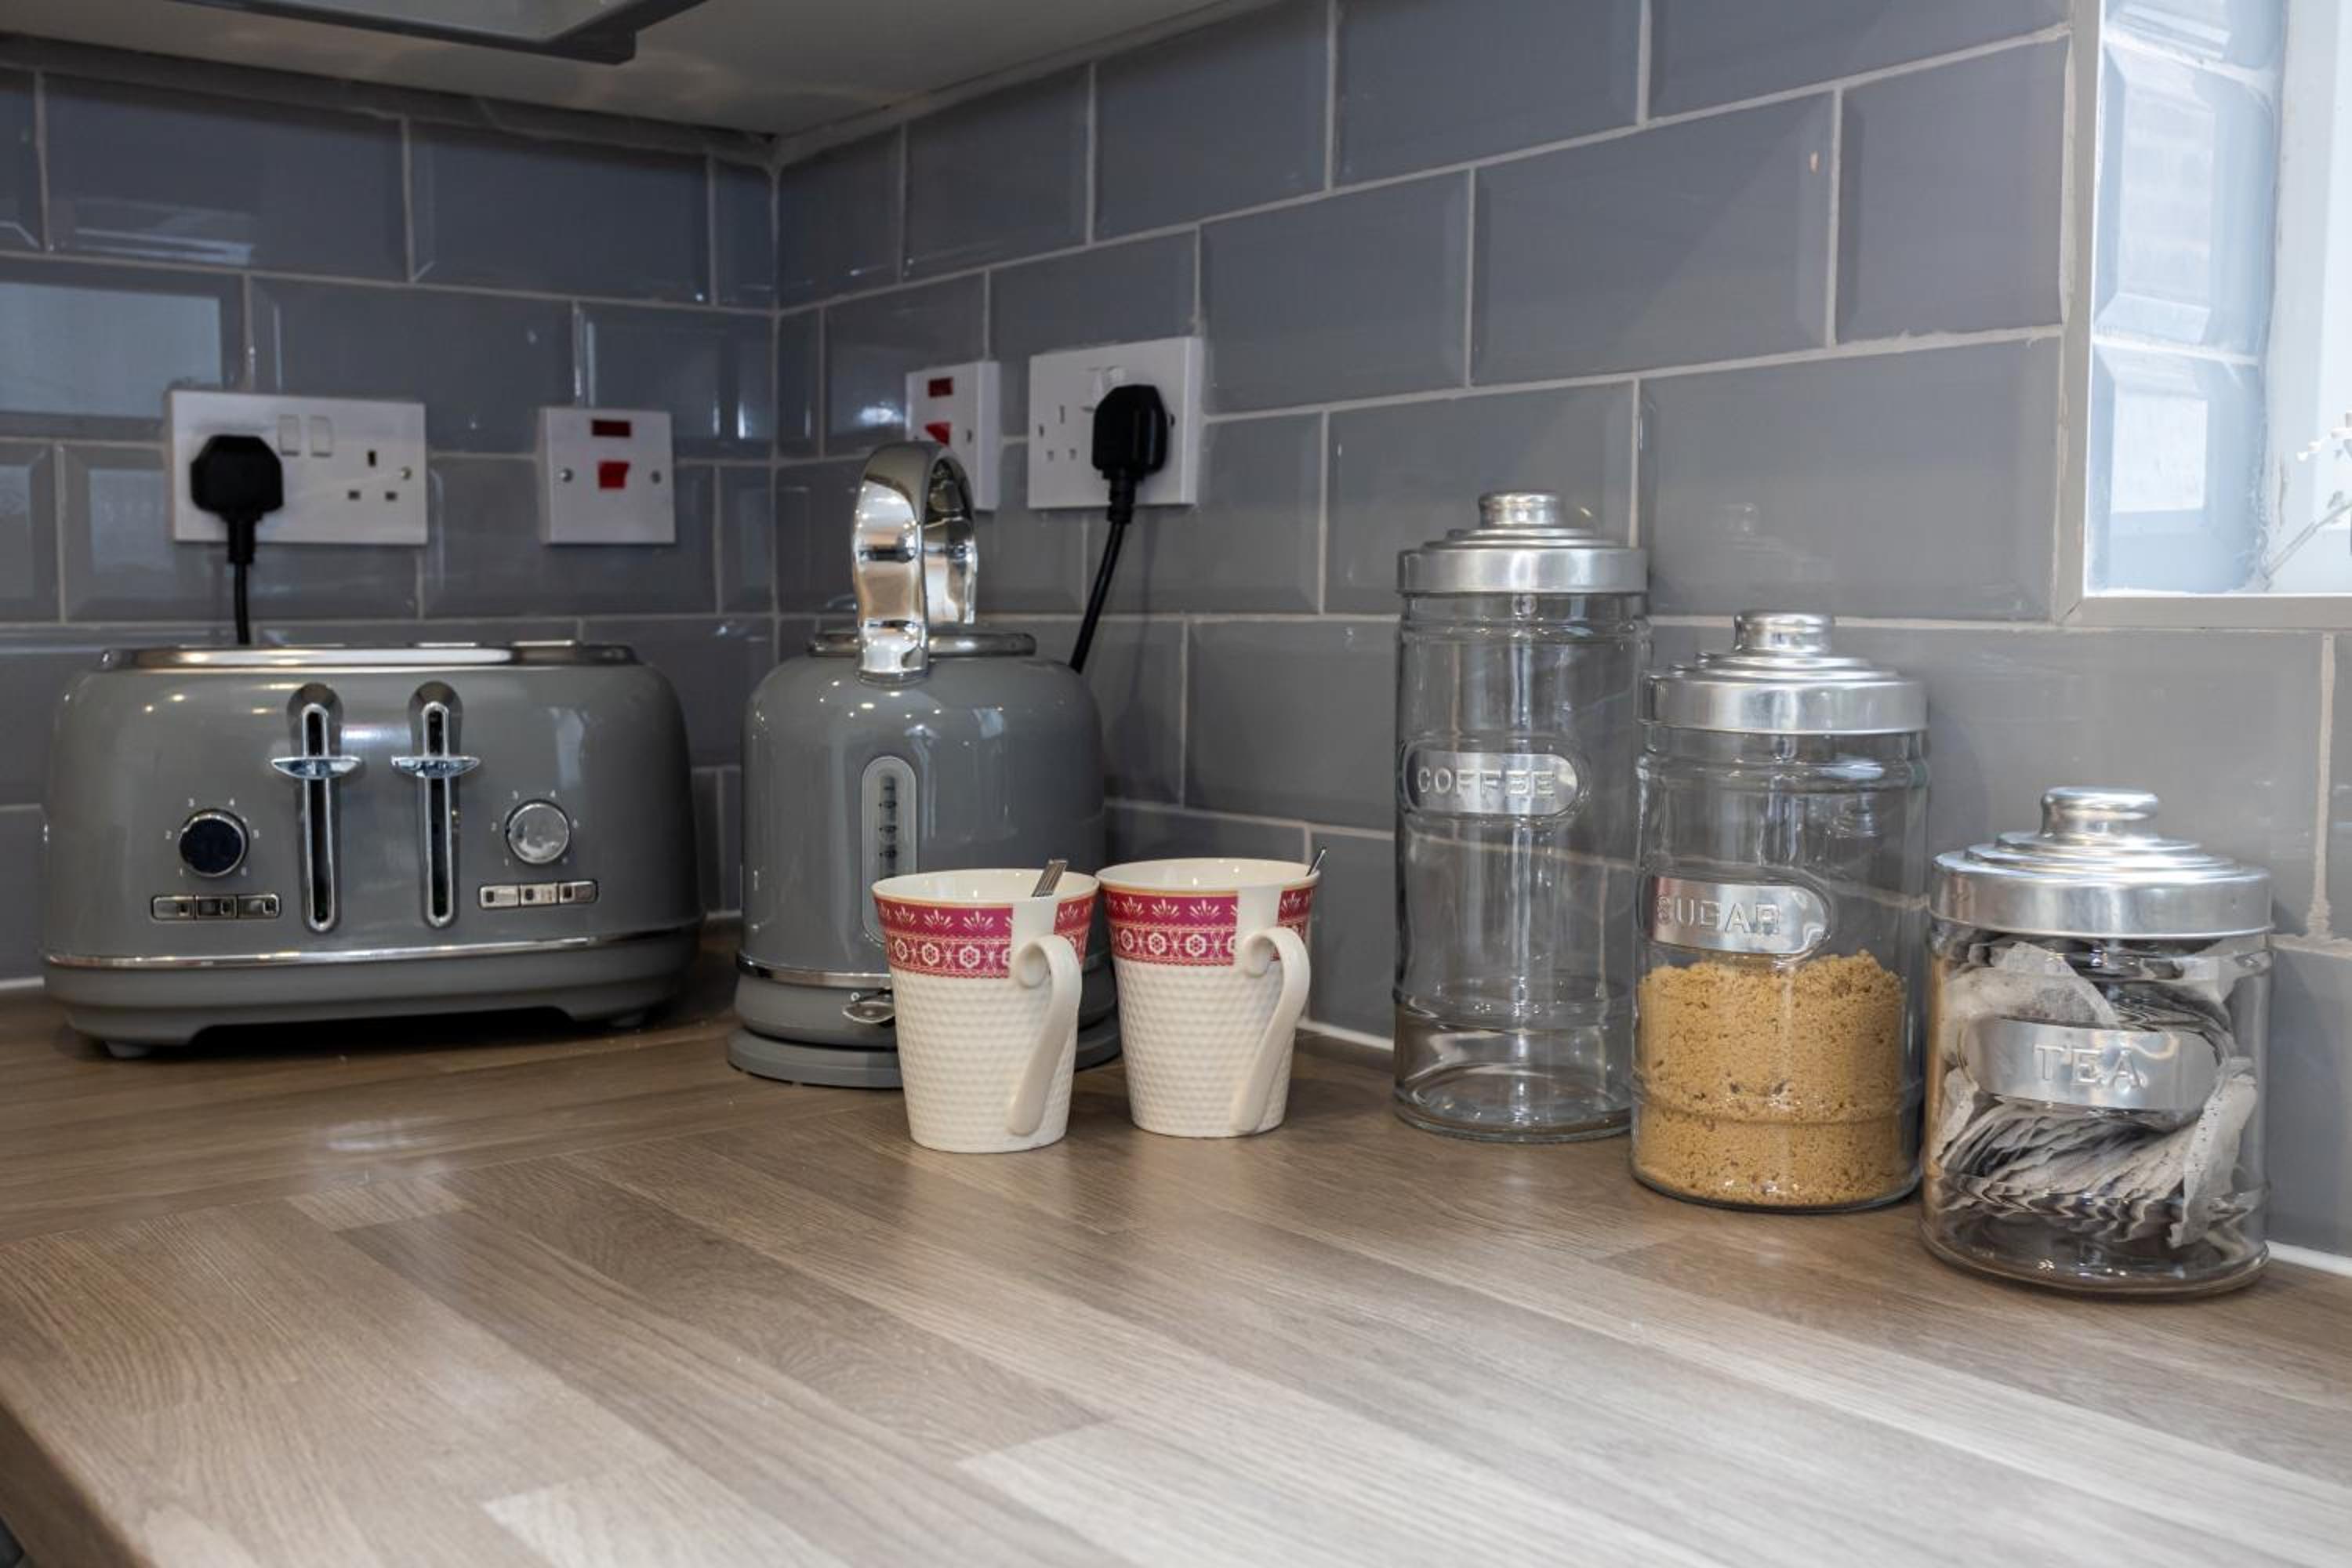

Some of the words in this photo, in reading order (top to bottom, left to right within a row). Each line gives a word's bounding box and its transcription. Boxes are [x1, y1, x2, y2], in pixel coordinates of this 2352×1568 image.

[1417, 766, 1555, 797] COFFEE
[1655, 895, 1781, 935] SUGAR
[2033, 1043, 2147, 1091] TEA
